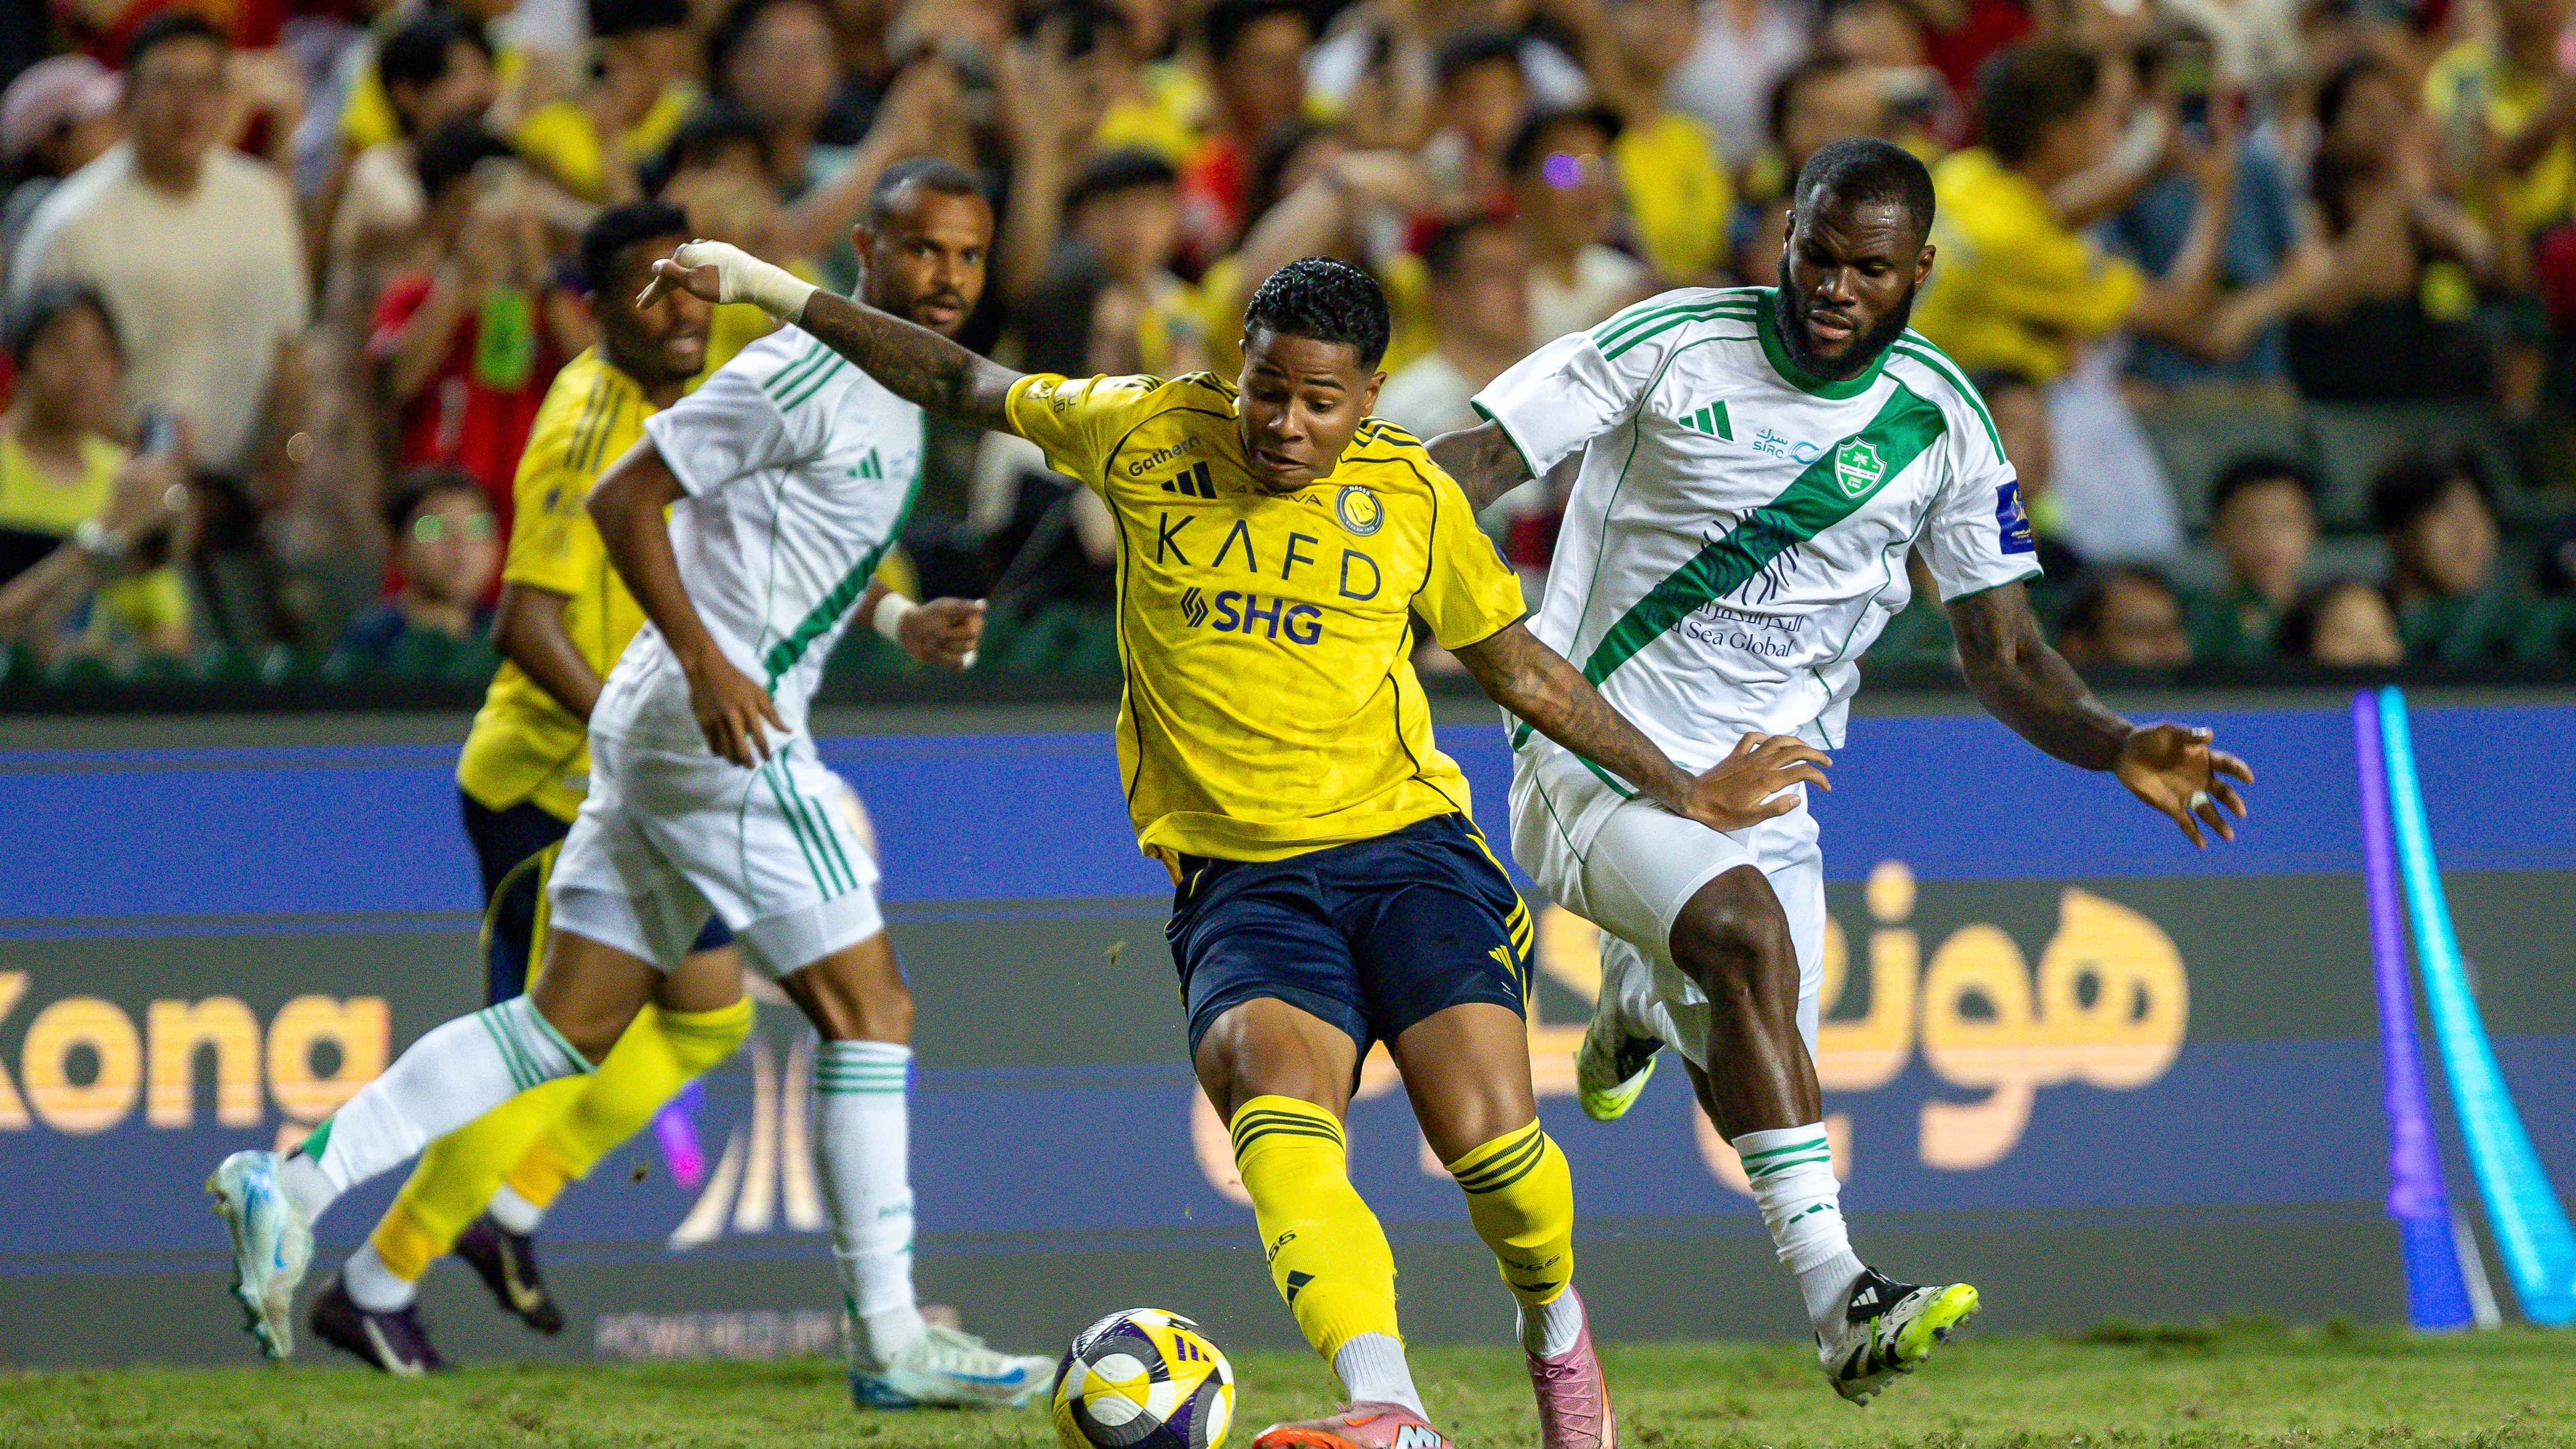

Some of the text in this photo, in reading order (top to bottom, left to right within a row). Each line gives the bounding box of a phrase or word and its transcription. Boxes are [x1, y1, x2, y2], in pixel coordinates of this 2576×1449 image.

[1128, 436, 1201, 476] Gathern
[1752, 440, 1784, 458] SIRC
[1156, 512, 1381, 601] KAFD
[1212, 590, 1324, 645] SHG
[1686, 621, 1723, 645] Sea
[1729, 632, 1795, 657] Global
[0, 969, 391, 1154] ong
